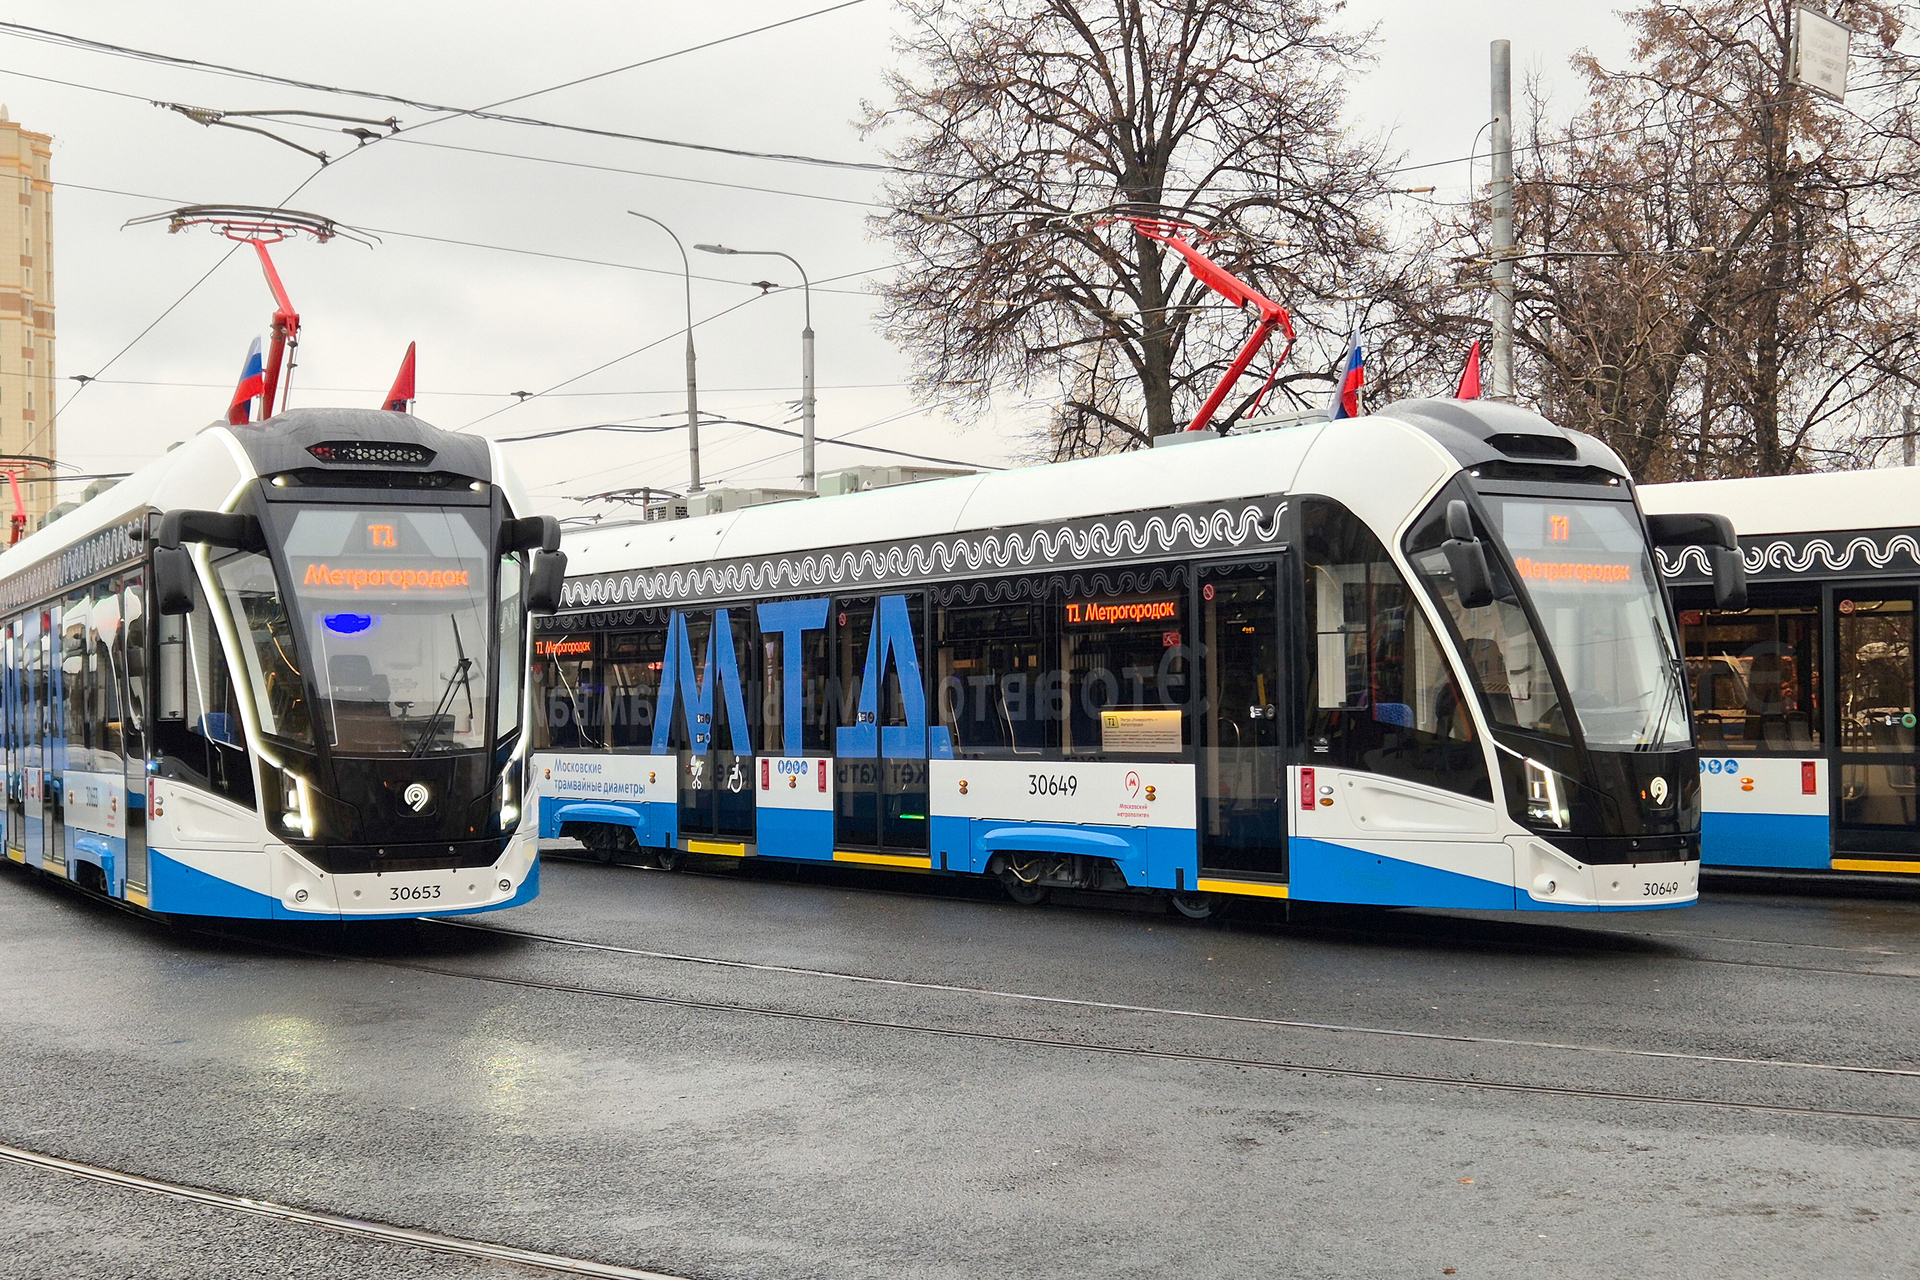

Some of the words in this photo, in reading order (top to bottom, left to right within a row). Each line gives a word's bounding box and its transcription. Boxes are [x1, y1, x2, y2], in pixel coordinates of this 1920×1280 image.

[303, 564, 468, 590] Метрогородок
[1515, 557, 1631, 583] Метрогородок
[1085, 602, 1175, 624] Метрогородок
[650, 595, 954, 759] МТД
[554, 758, 602, 774] Московские
[554, 778, 602, 792] трамвайные
[603, 782, 645, 797] диаметры
[1028, 774, 1078, 797] 30649
[1118, 803, 1148, 811] Московский
[389, 885, 441, 901] 30653
[1643, 881, 1679, 896] 30649
